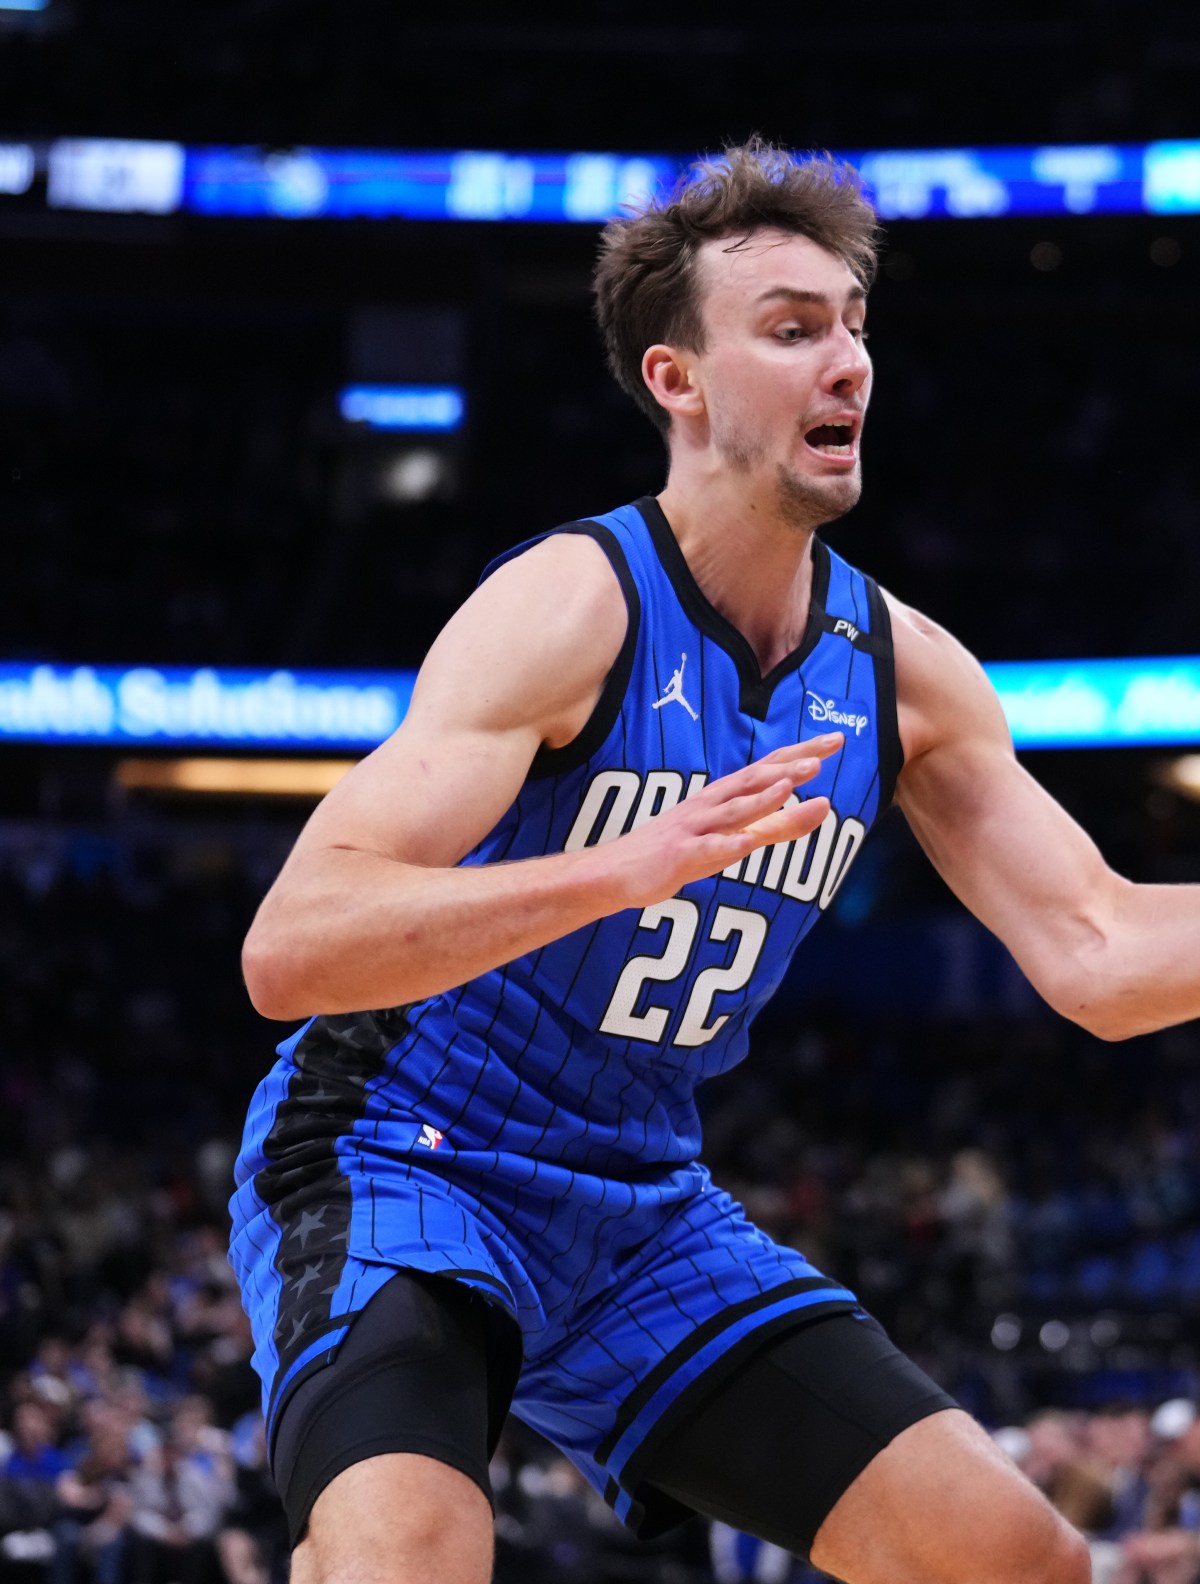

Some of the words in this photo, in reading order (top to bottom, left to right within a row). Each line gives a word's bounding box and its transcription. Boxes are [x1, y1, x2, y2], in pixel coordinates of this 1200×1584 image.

[833, 619, 859, 641] PW
[118, 668, 398, 741] Solutions
[806, 690, 868, 736] Disney
[598, 897, 768, 1047] 22
